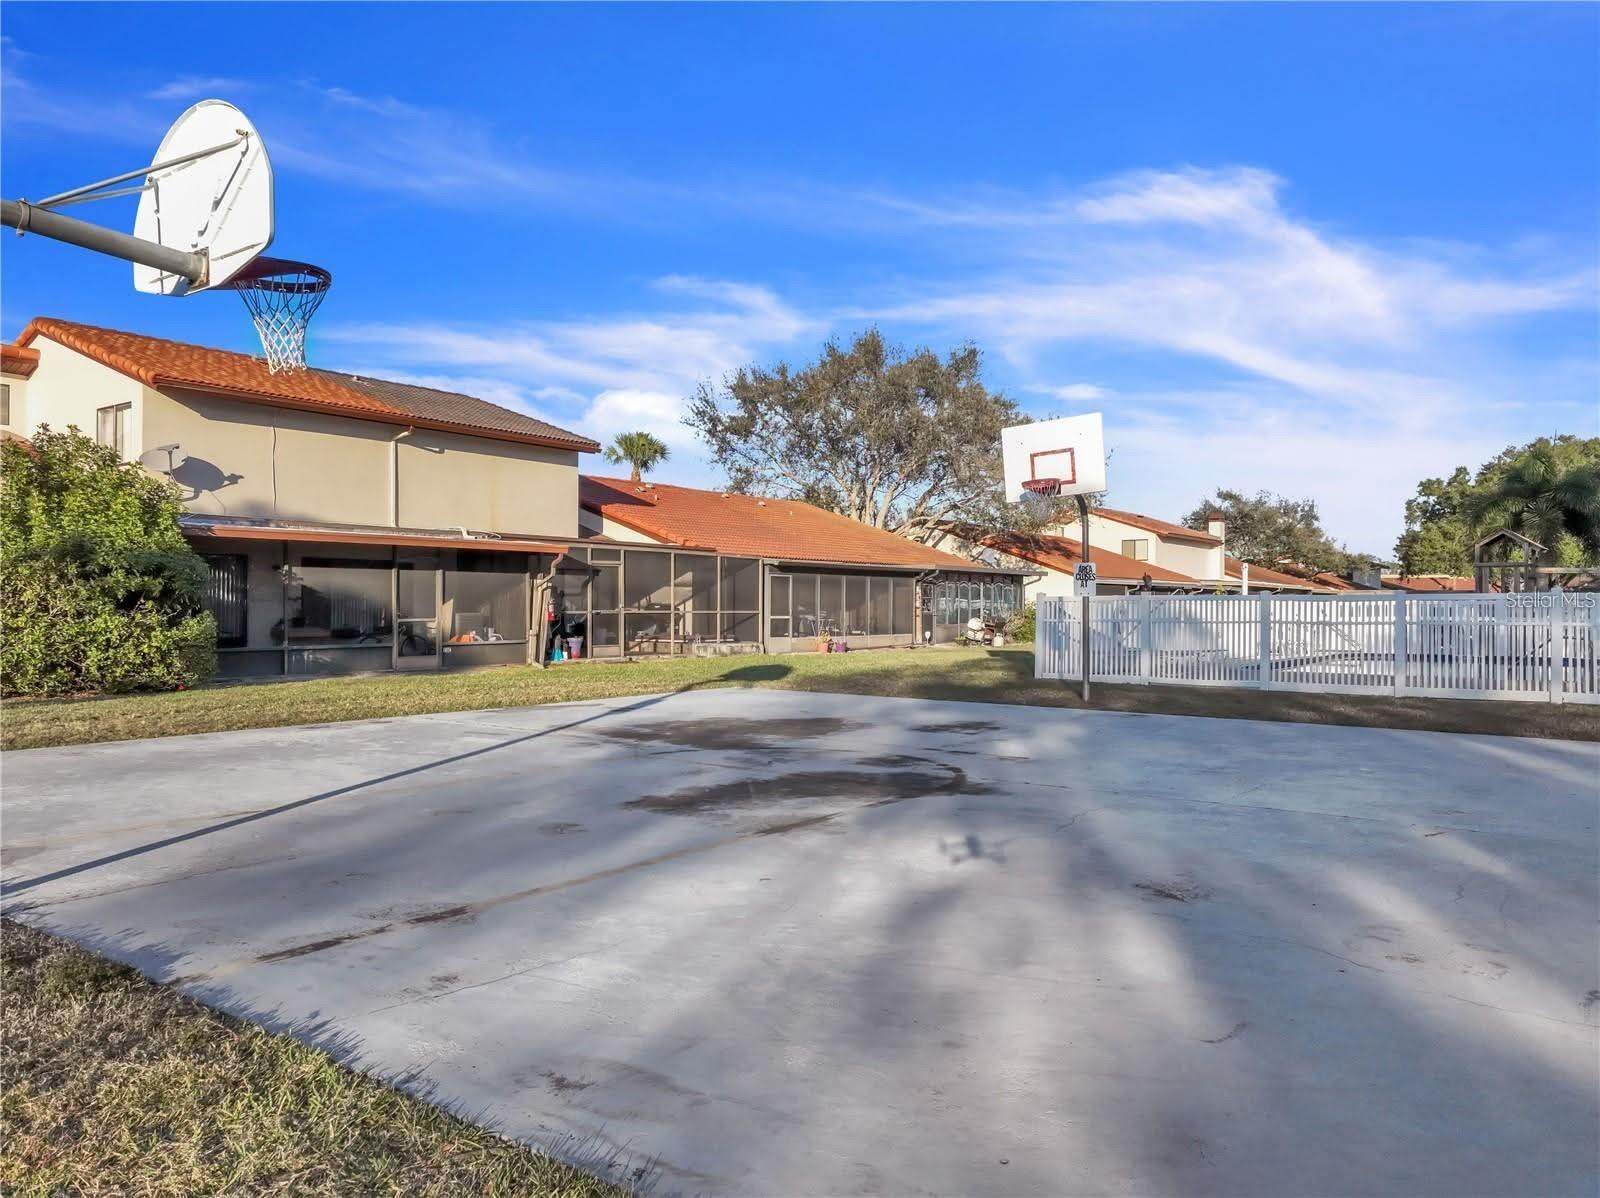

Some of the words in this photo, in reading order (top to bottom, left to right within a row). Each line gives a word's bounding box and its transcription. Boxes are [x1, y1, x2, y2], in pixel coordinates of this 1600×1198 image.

[1078, 564, 1092, 573] AREA
[1075, 572, 1096, 581] CLOSES
[1080, 580, 1088, 588] AT
